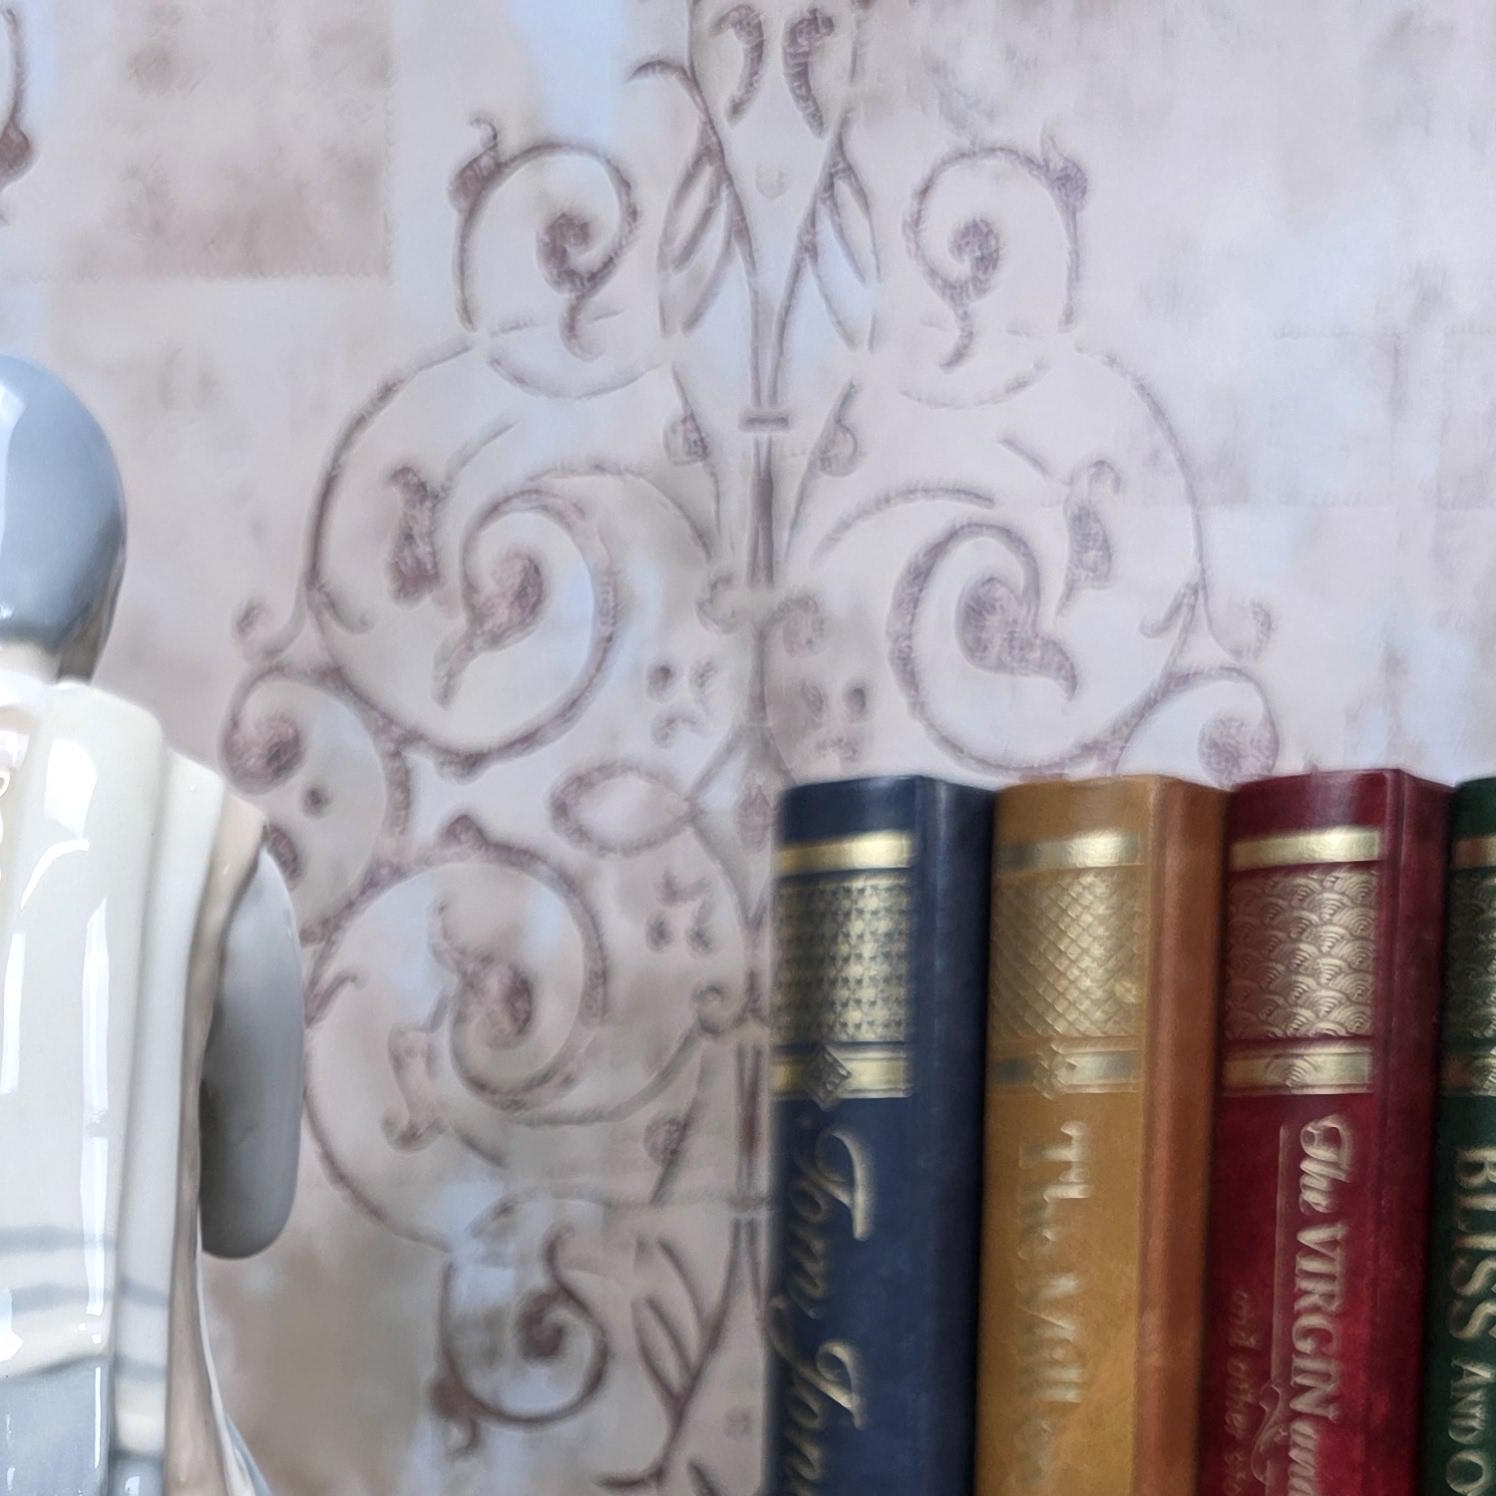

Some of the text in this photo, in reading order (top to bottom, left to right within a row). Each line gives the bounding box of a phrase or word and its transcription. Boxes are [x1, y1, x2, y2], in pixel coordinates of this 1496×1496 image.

[1017, 1119, 1095, 1261] The
[1300, 1113, 1353, 1215] The
[1448, 1146, 1496, 1342] BLISS
[1288, 1223, 1350, 1424] VIRGIN
[1447, 1358, 1495, 1443] AND
